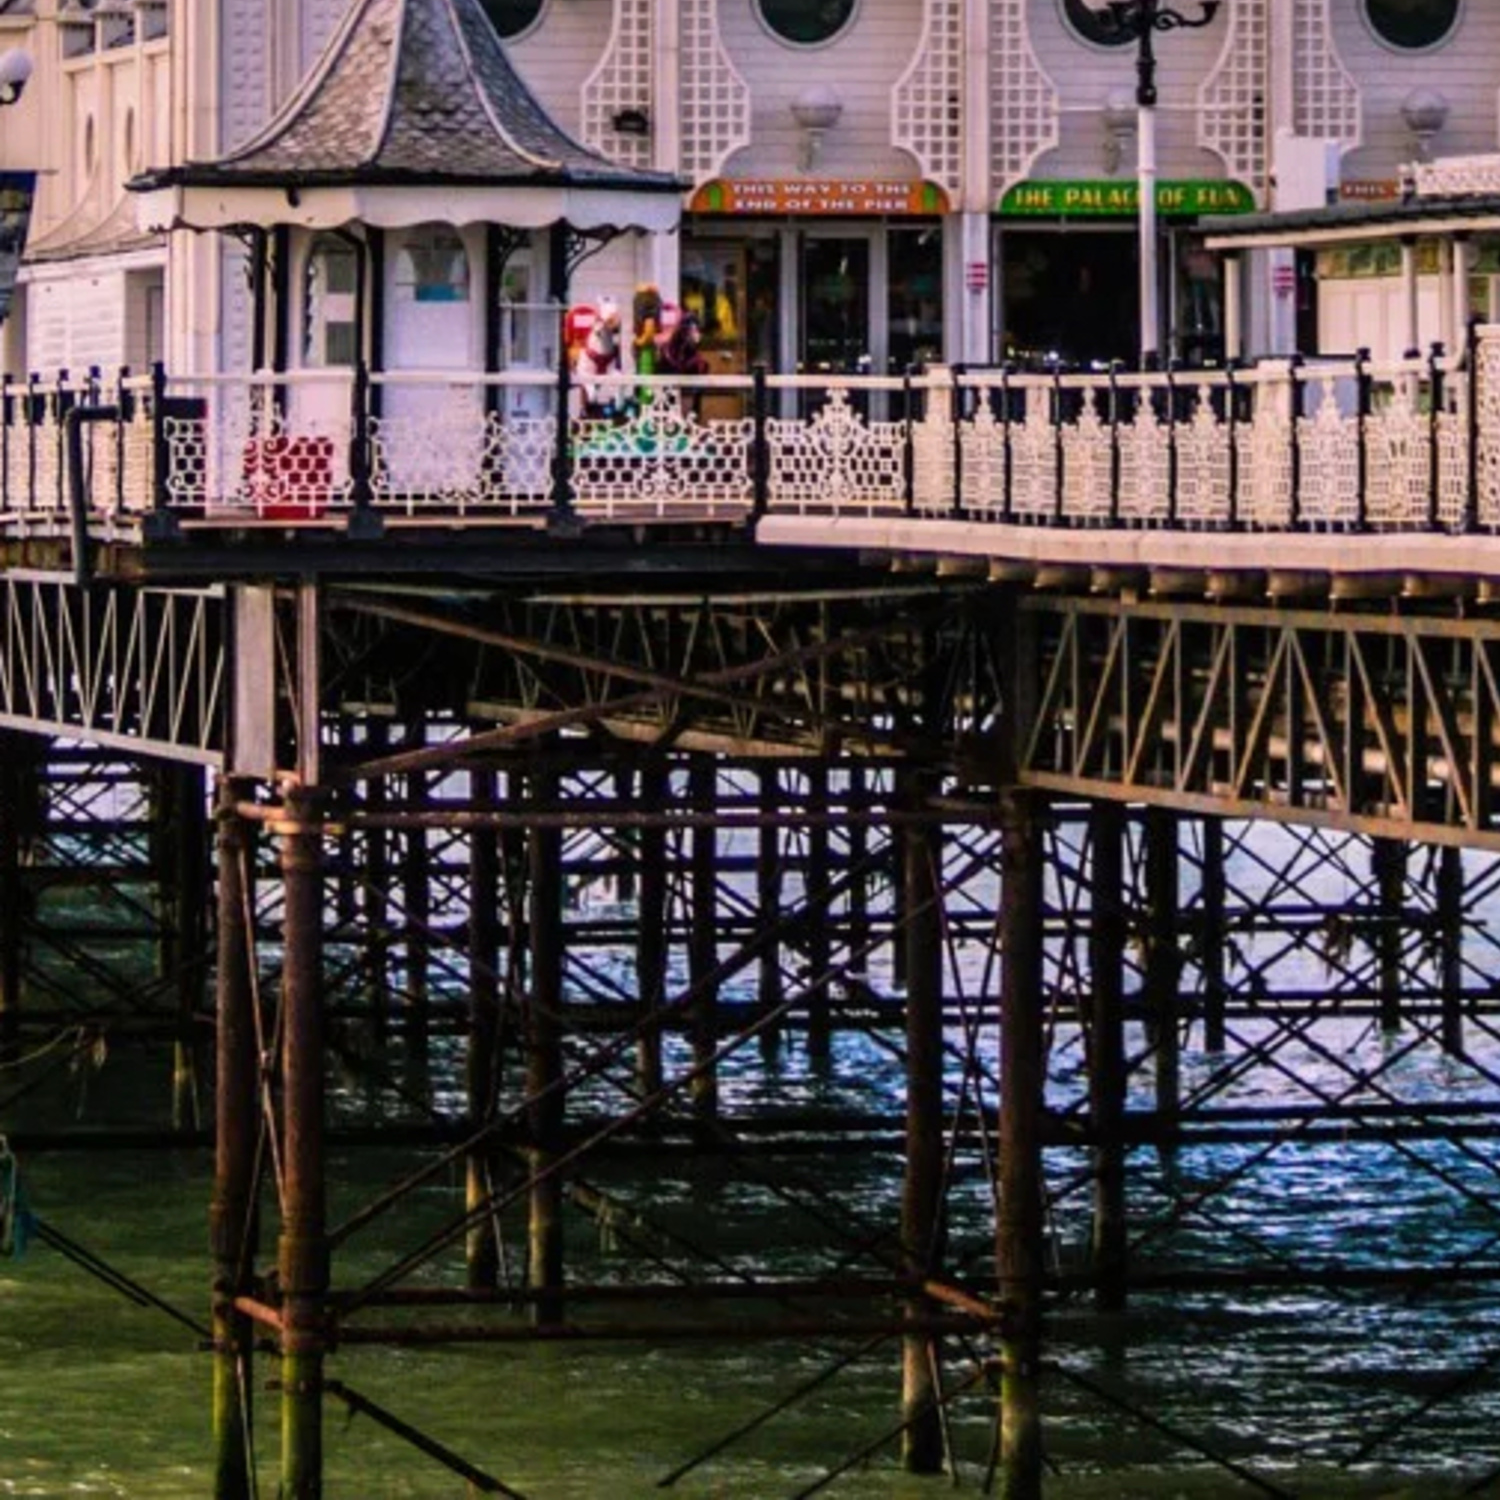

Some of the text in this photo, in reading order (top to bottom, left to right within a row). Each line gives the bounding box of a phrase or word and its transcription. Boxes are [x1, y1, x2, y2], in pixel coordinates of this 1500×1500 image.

[732, 183, 910, 194] THIS WAY TO THE
[1015, 188, 1240, 207] THE PALAC OF FUN
[735, 199, 909, 211] END OF THE PIER
